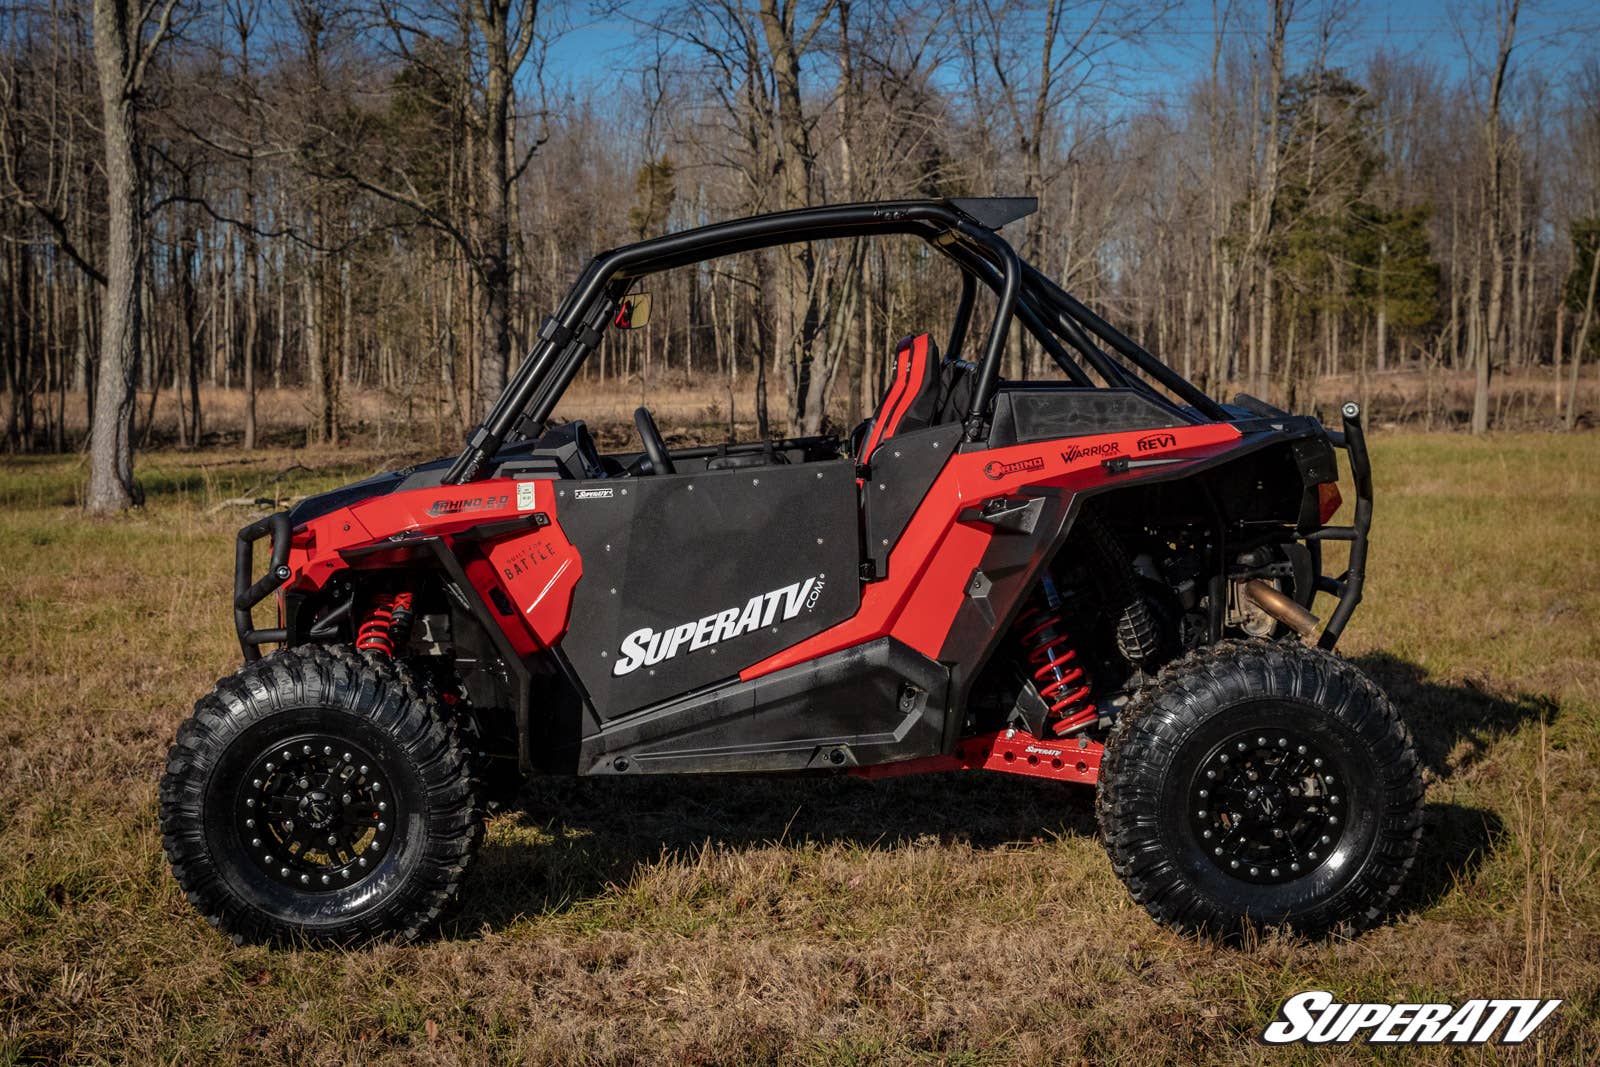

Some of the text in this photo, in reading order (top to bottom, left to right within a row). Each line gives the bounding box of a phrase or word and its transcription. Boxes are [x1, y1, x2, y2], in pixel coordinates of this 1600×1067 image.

[1061, 442, 1121, 464] WARRIOR
[1001, 458, 1043, 475] RHINO
[432, 498, 482, 511] RHINO
[504, 543, 555, 580] BATTLE
[613, 577, 816, 677] SUPERATV
